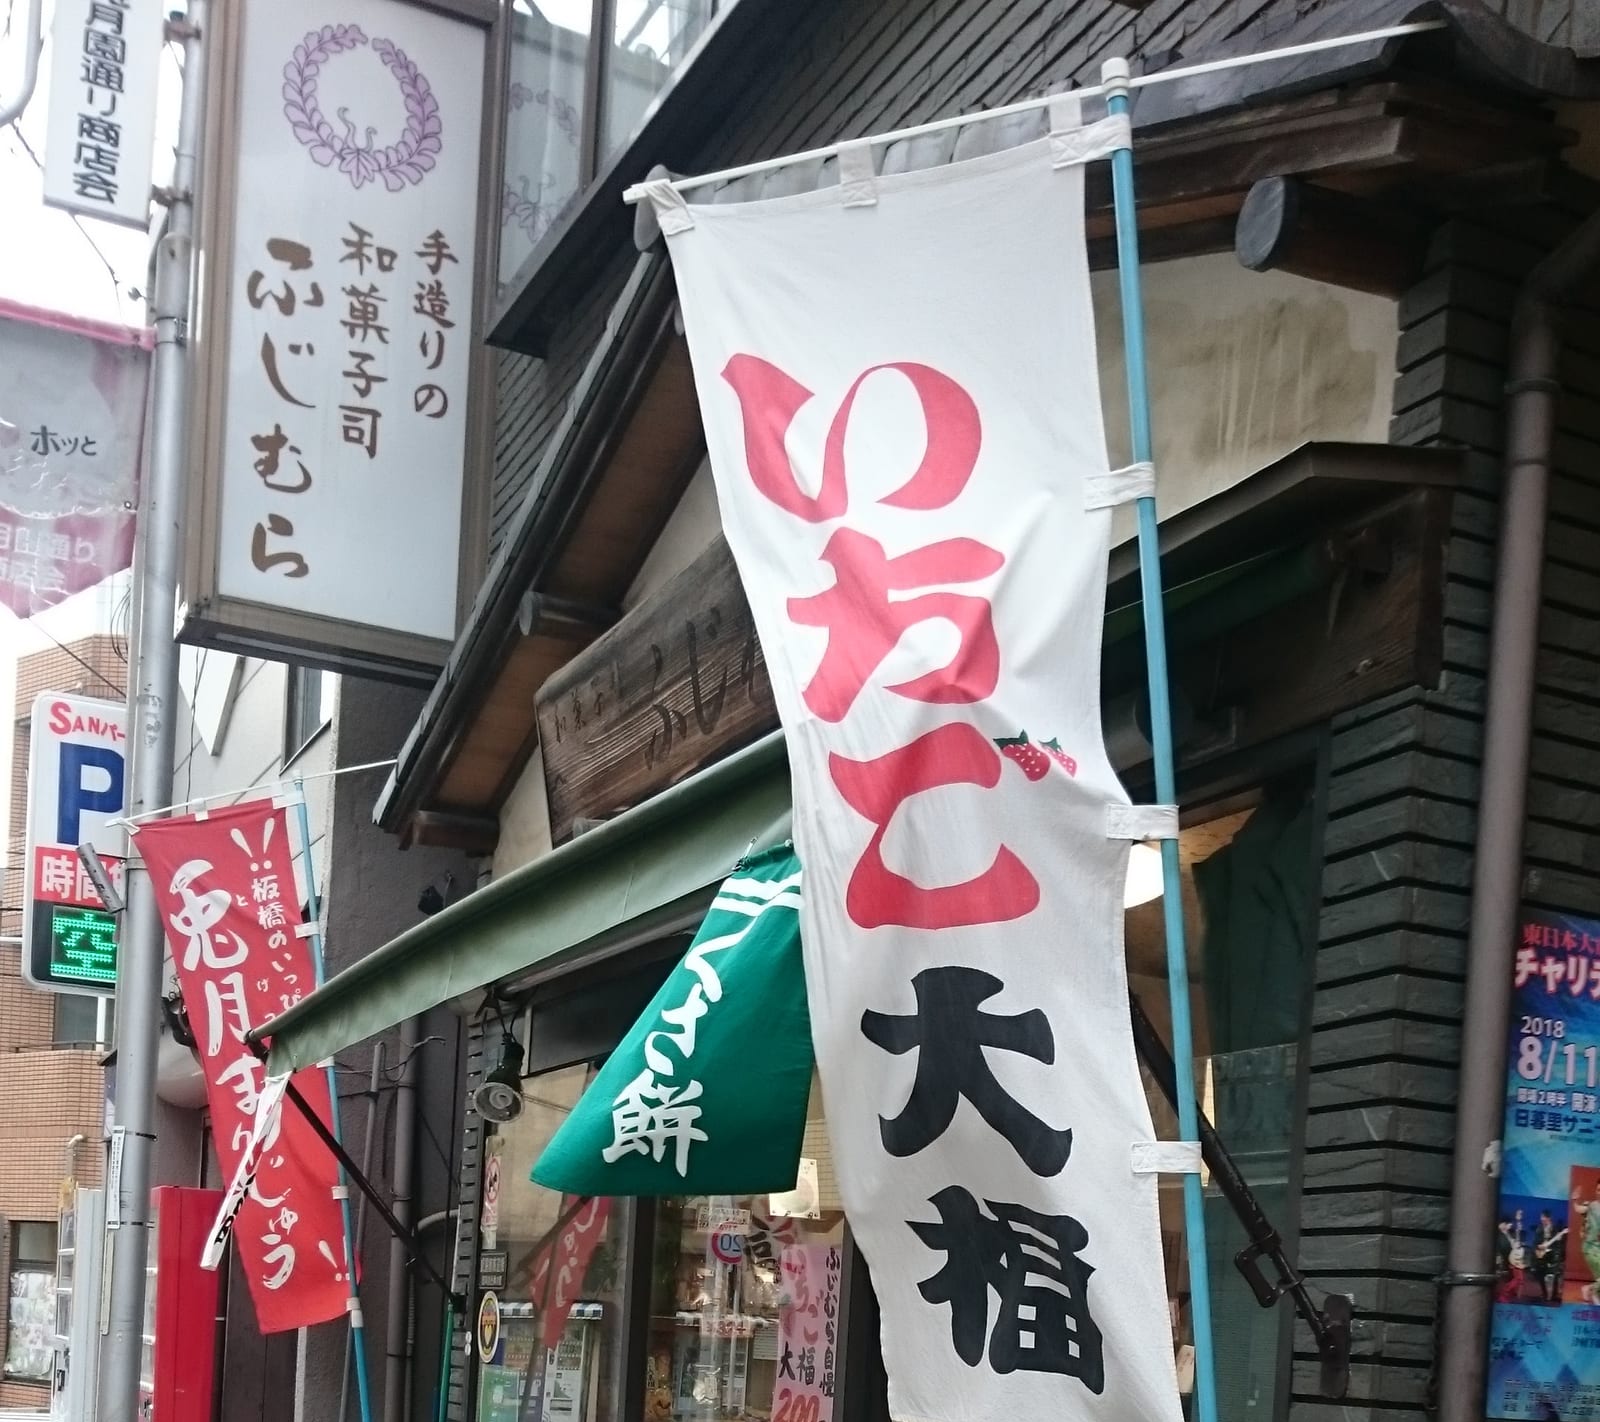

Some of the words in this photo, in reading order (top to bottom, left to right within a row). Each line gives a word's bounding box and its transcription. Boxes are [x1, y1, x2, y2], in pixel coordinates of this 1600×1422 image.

[73, 0, 130, 204] 月園通り商店会
[338, 222, 398, 459] 和菓子司
[413, 229, 459, 419] 手造りの
[247, 238, 323, 578] ふじむら
[57, 741, 124, 845] P
[50, 912, 117, 979] 空
[1523, 923, 1600, 957] 東日本大
[602, 915, 758, 1177] くさ餅
[1517, 1036, 1599, 1088] 8/11
[1520, 1016, 1566, 1039] 2018
[779, 1342, 815, 1385] 大福
